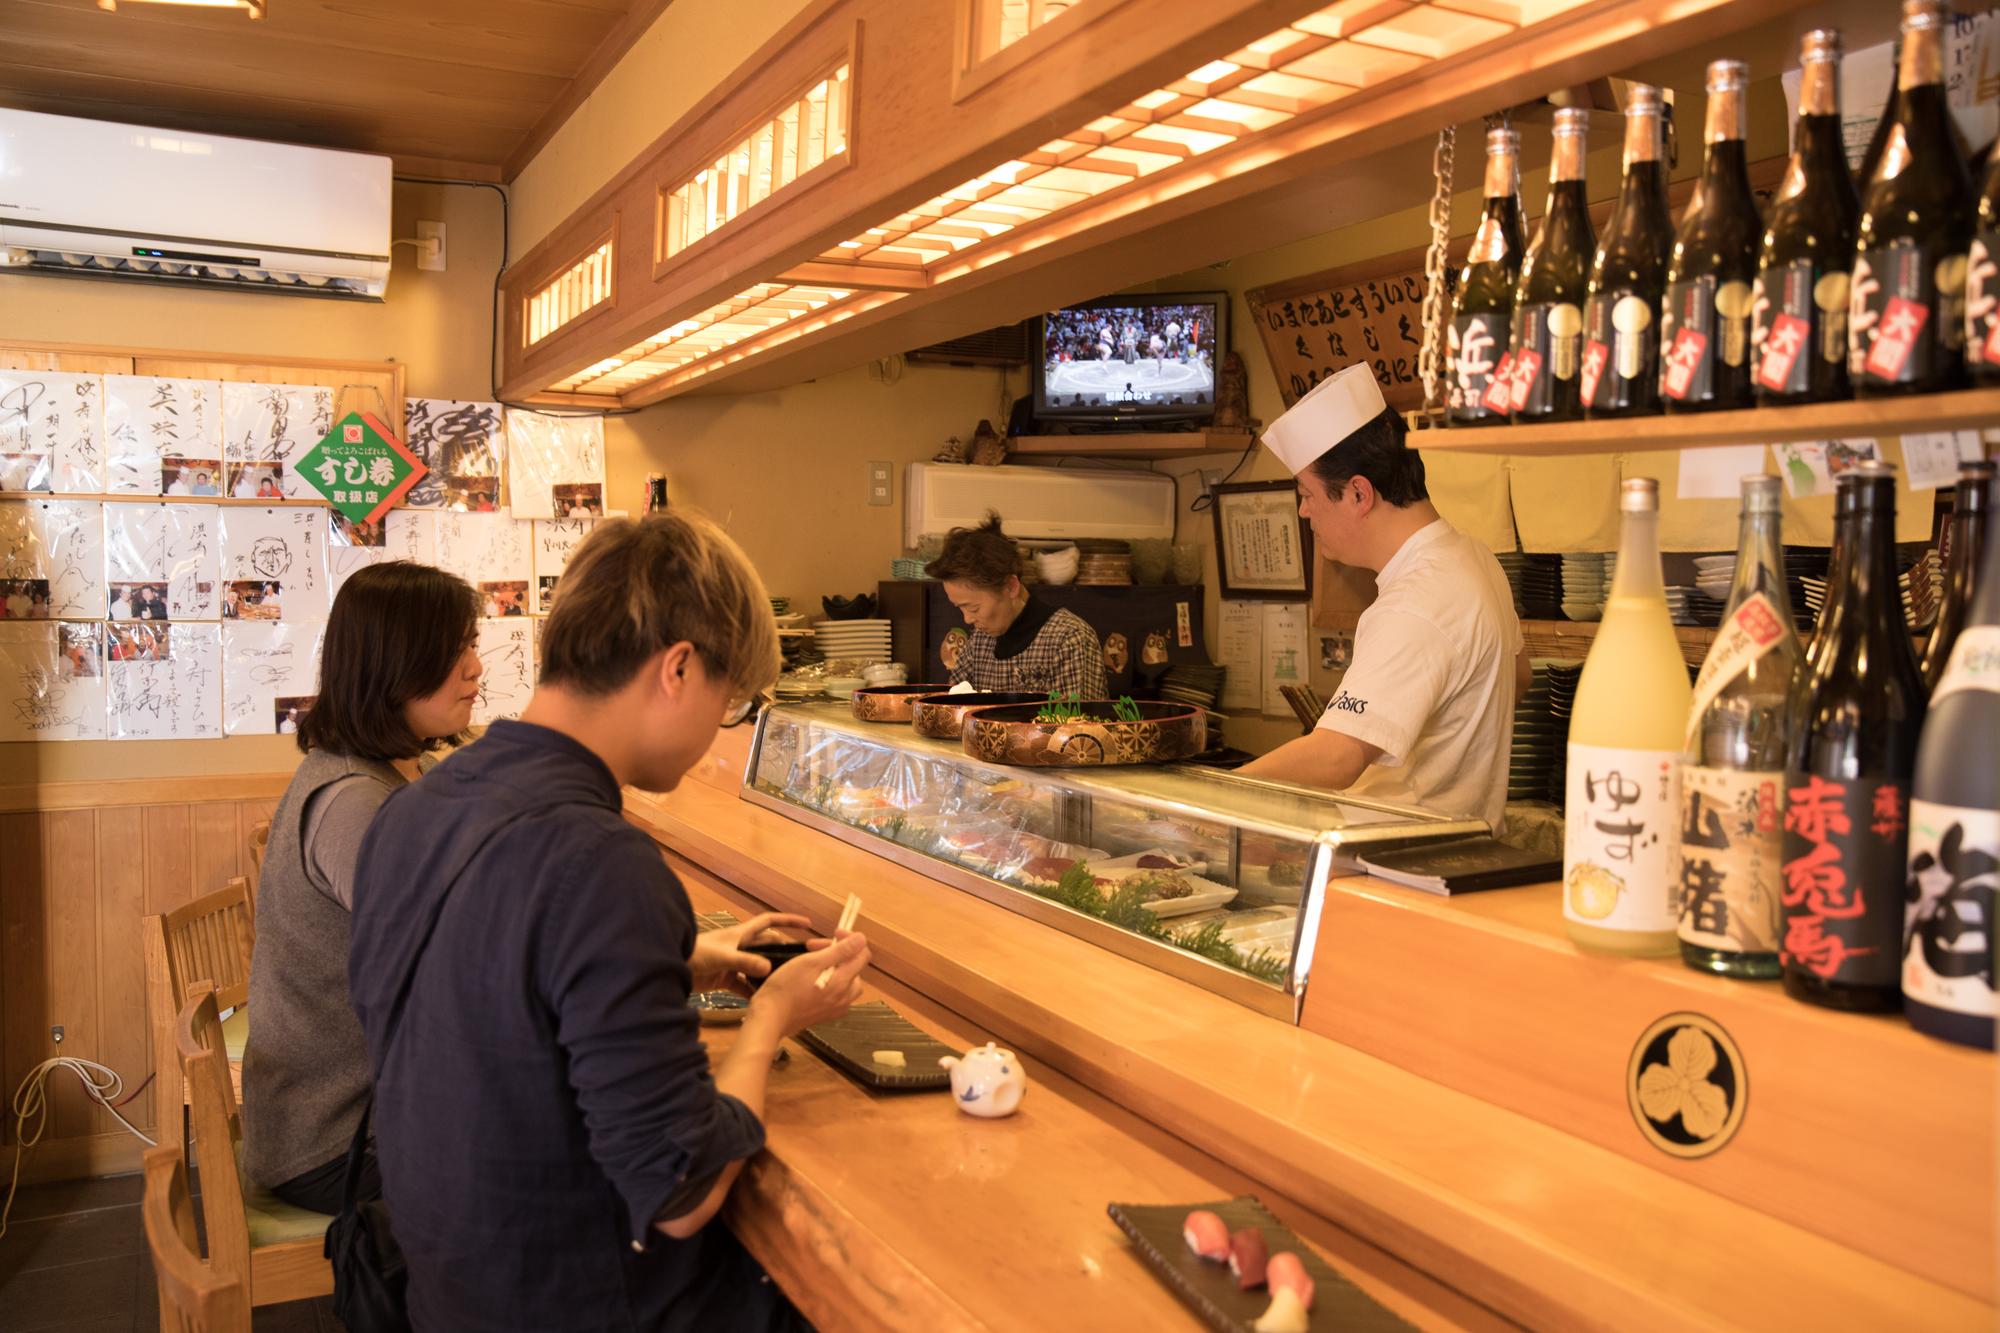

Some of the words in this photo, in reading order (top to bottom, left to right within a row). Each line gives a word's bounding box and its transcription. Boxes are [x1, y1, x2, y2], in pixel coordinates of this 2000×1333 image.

[314, 456, 395, 486] すし券
[333, 490, 379, 504] 取扱店
[1337, 696, 1369, 714] asics
[1585, 770, 1658, 864] ゆず
[1779, 775, 1880, 978] 赤兎馬
